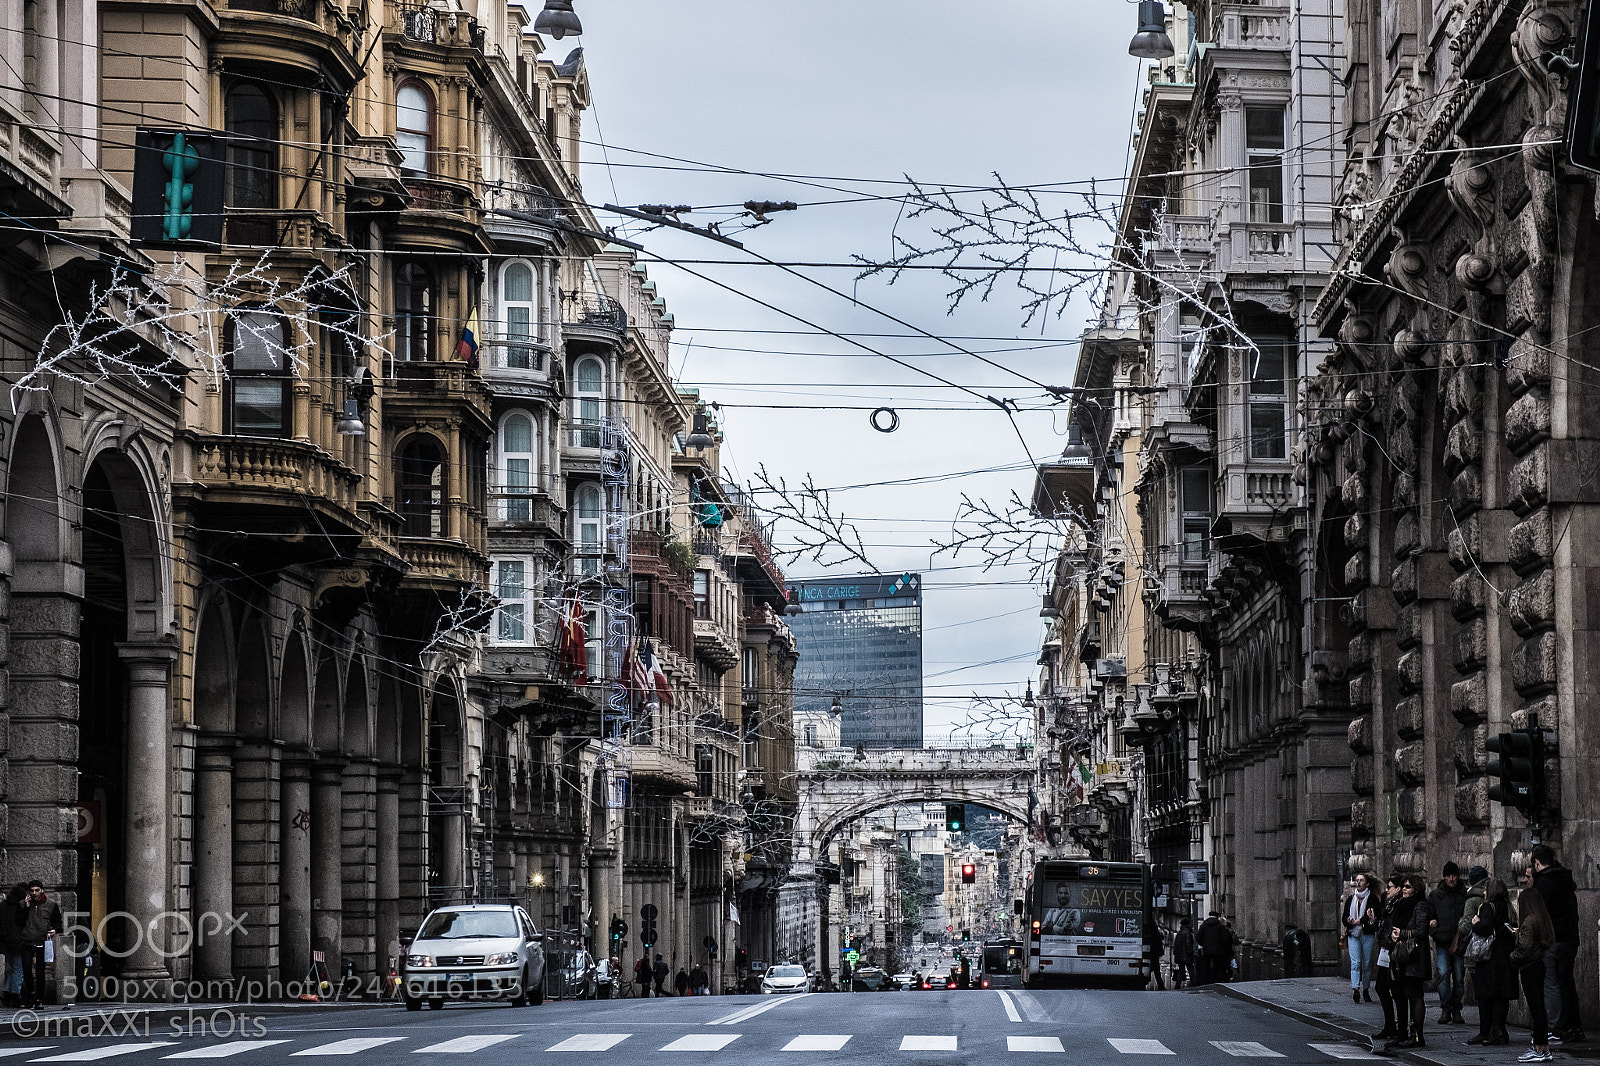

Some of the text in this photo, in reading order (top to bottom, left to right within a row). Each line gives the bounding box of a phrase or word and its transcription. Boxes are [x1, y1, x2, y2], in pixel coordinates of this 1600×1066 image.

[827, 585, 860, 599] CARIGE
[1088, 866, 1099, 876] 36
[1081, 887, 1110, 908] SAY
[1113, 889, 1143, 908] YES
